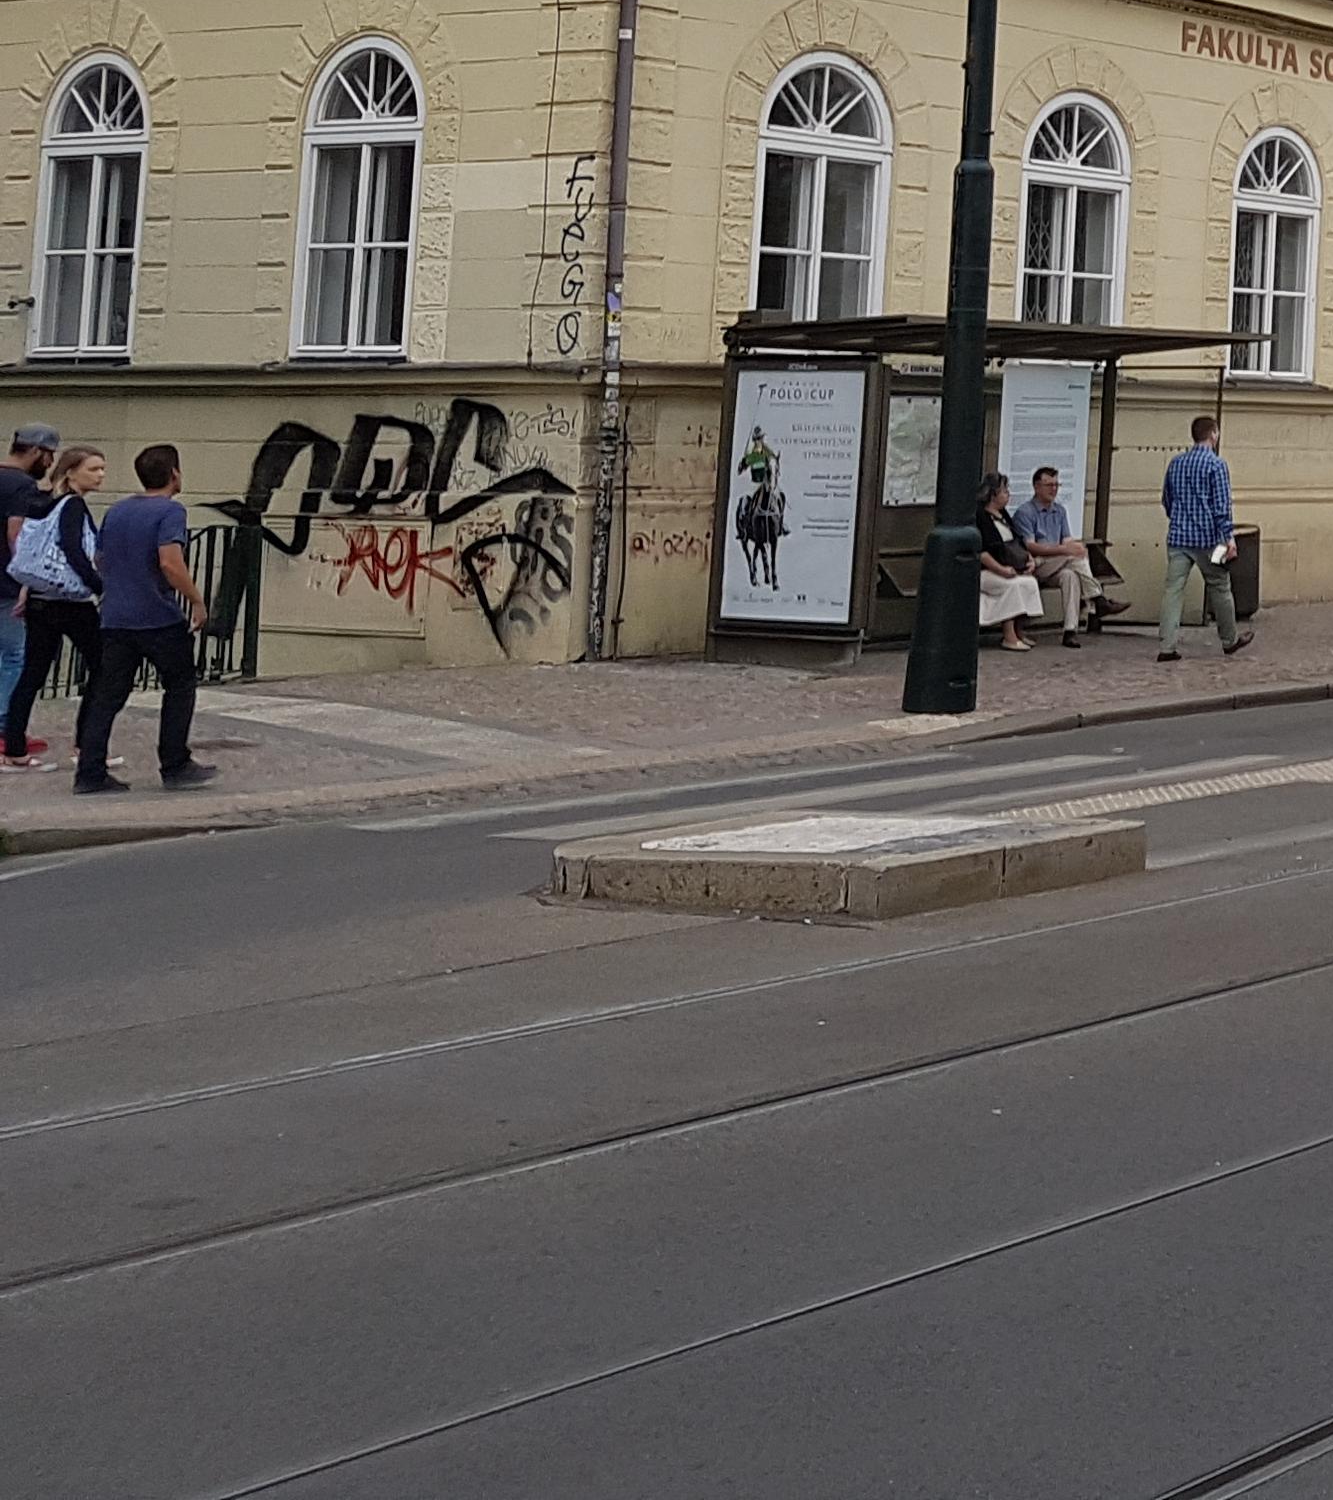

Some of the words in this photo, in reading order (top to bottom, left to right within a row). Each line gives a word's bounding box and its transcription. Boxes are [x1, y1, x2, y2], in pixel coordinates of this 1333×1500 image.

[1181, 20, 1299, 75] FAKULTA
[769, 388, 802, 401] POLO
[810, 388, 834, 400] CUP
